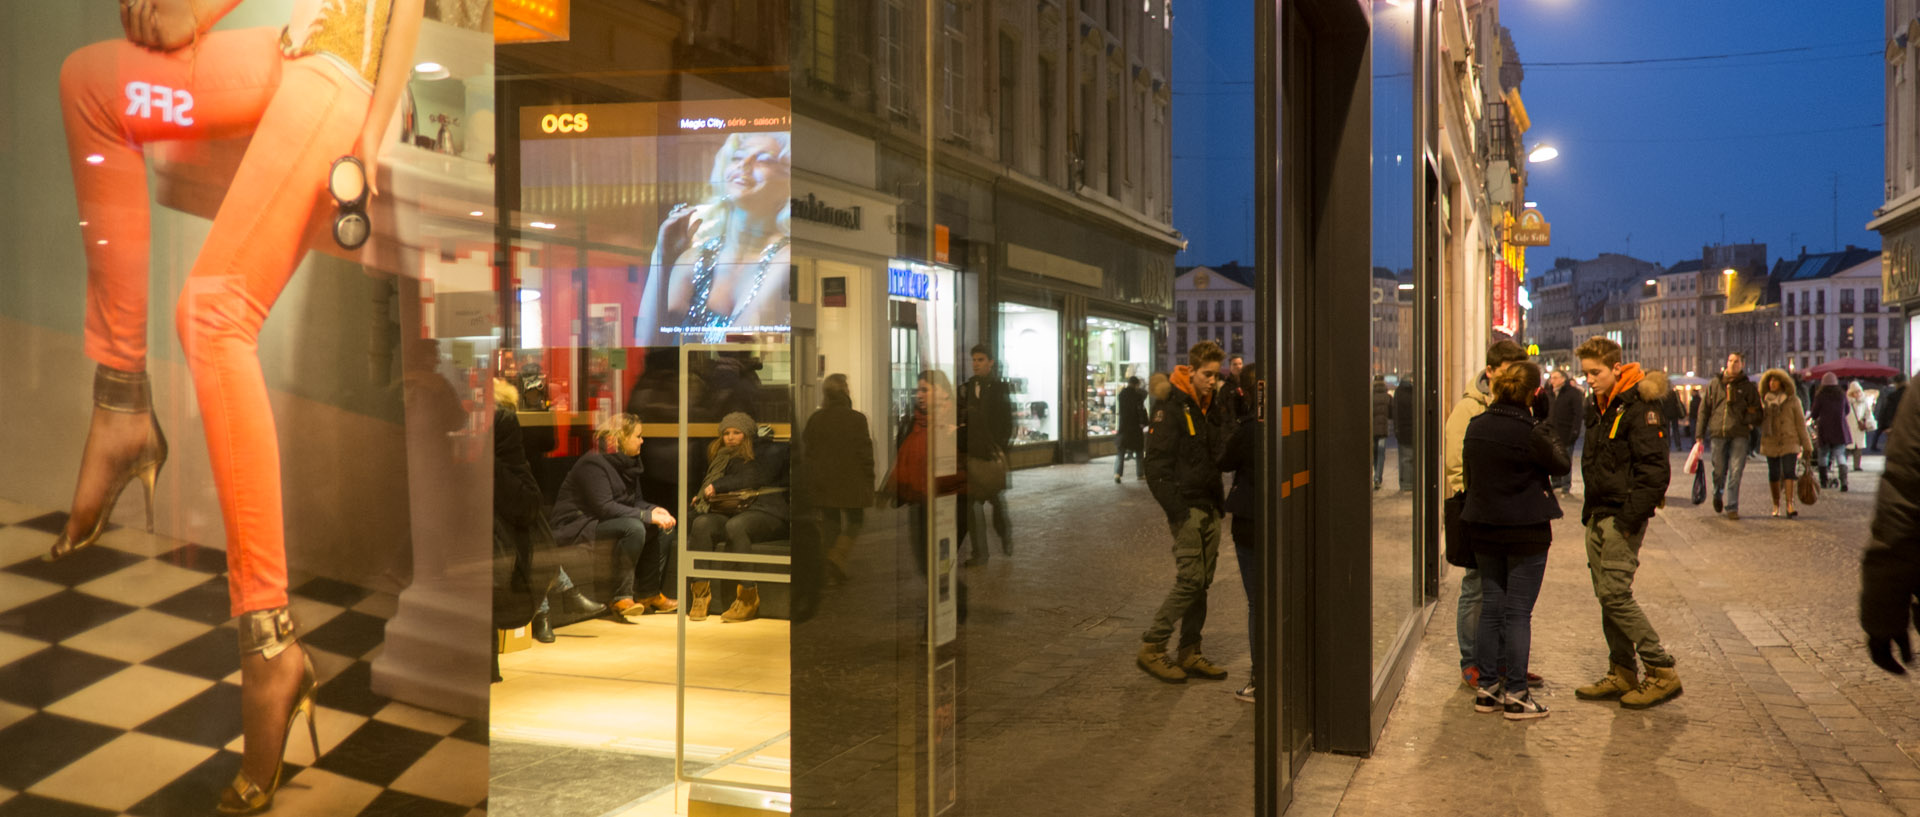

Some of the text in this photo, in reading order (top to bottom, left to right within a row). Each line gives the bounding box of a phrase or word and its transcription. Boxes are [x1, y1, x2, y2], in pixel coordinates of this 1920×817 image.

[541, 113, 588, 133] OCS
[681, 118, 706, 130] Magic
[707, 117, 726, 129] City,
[753, 116, 779, 126] saison
